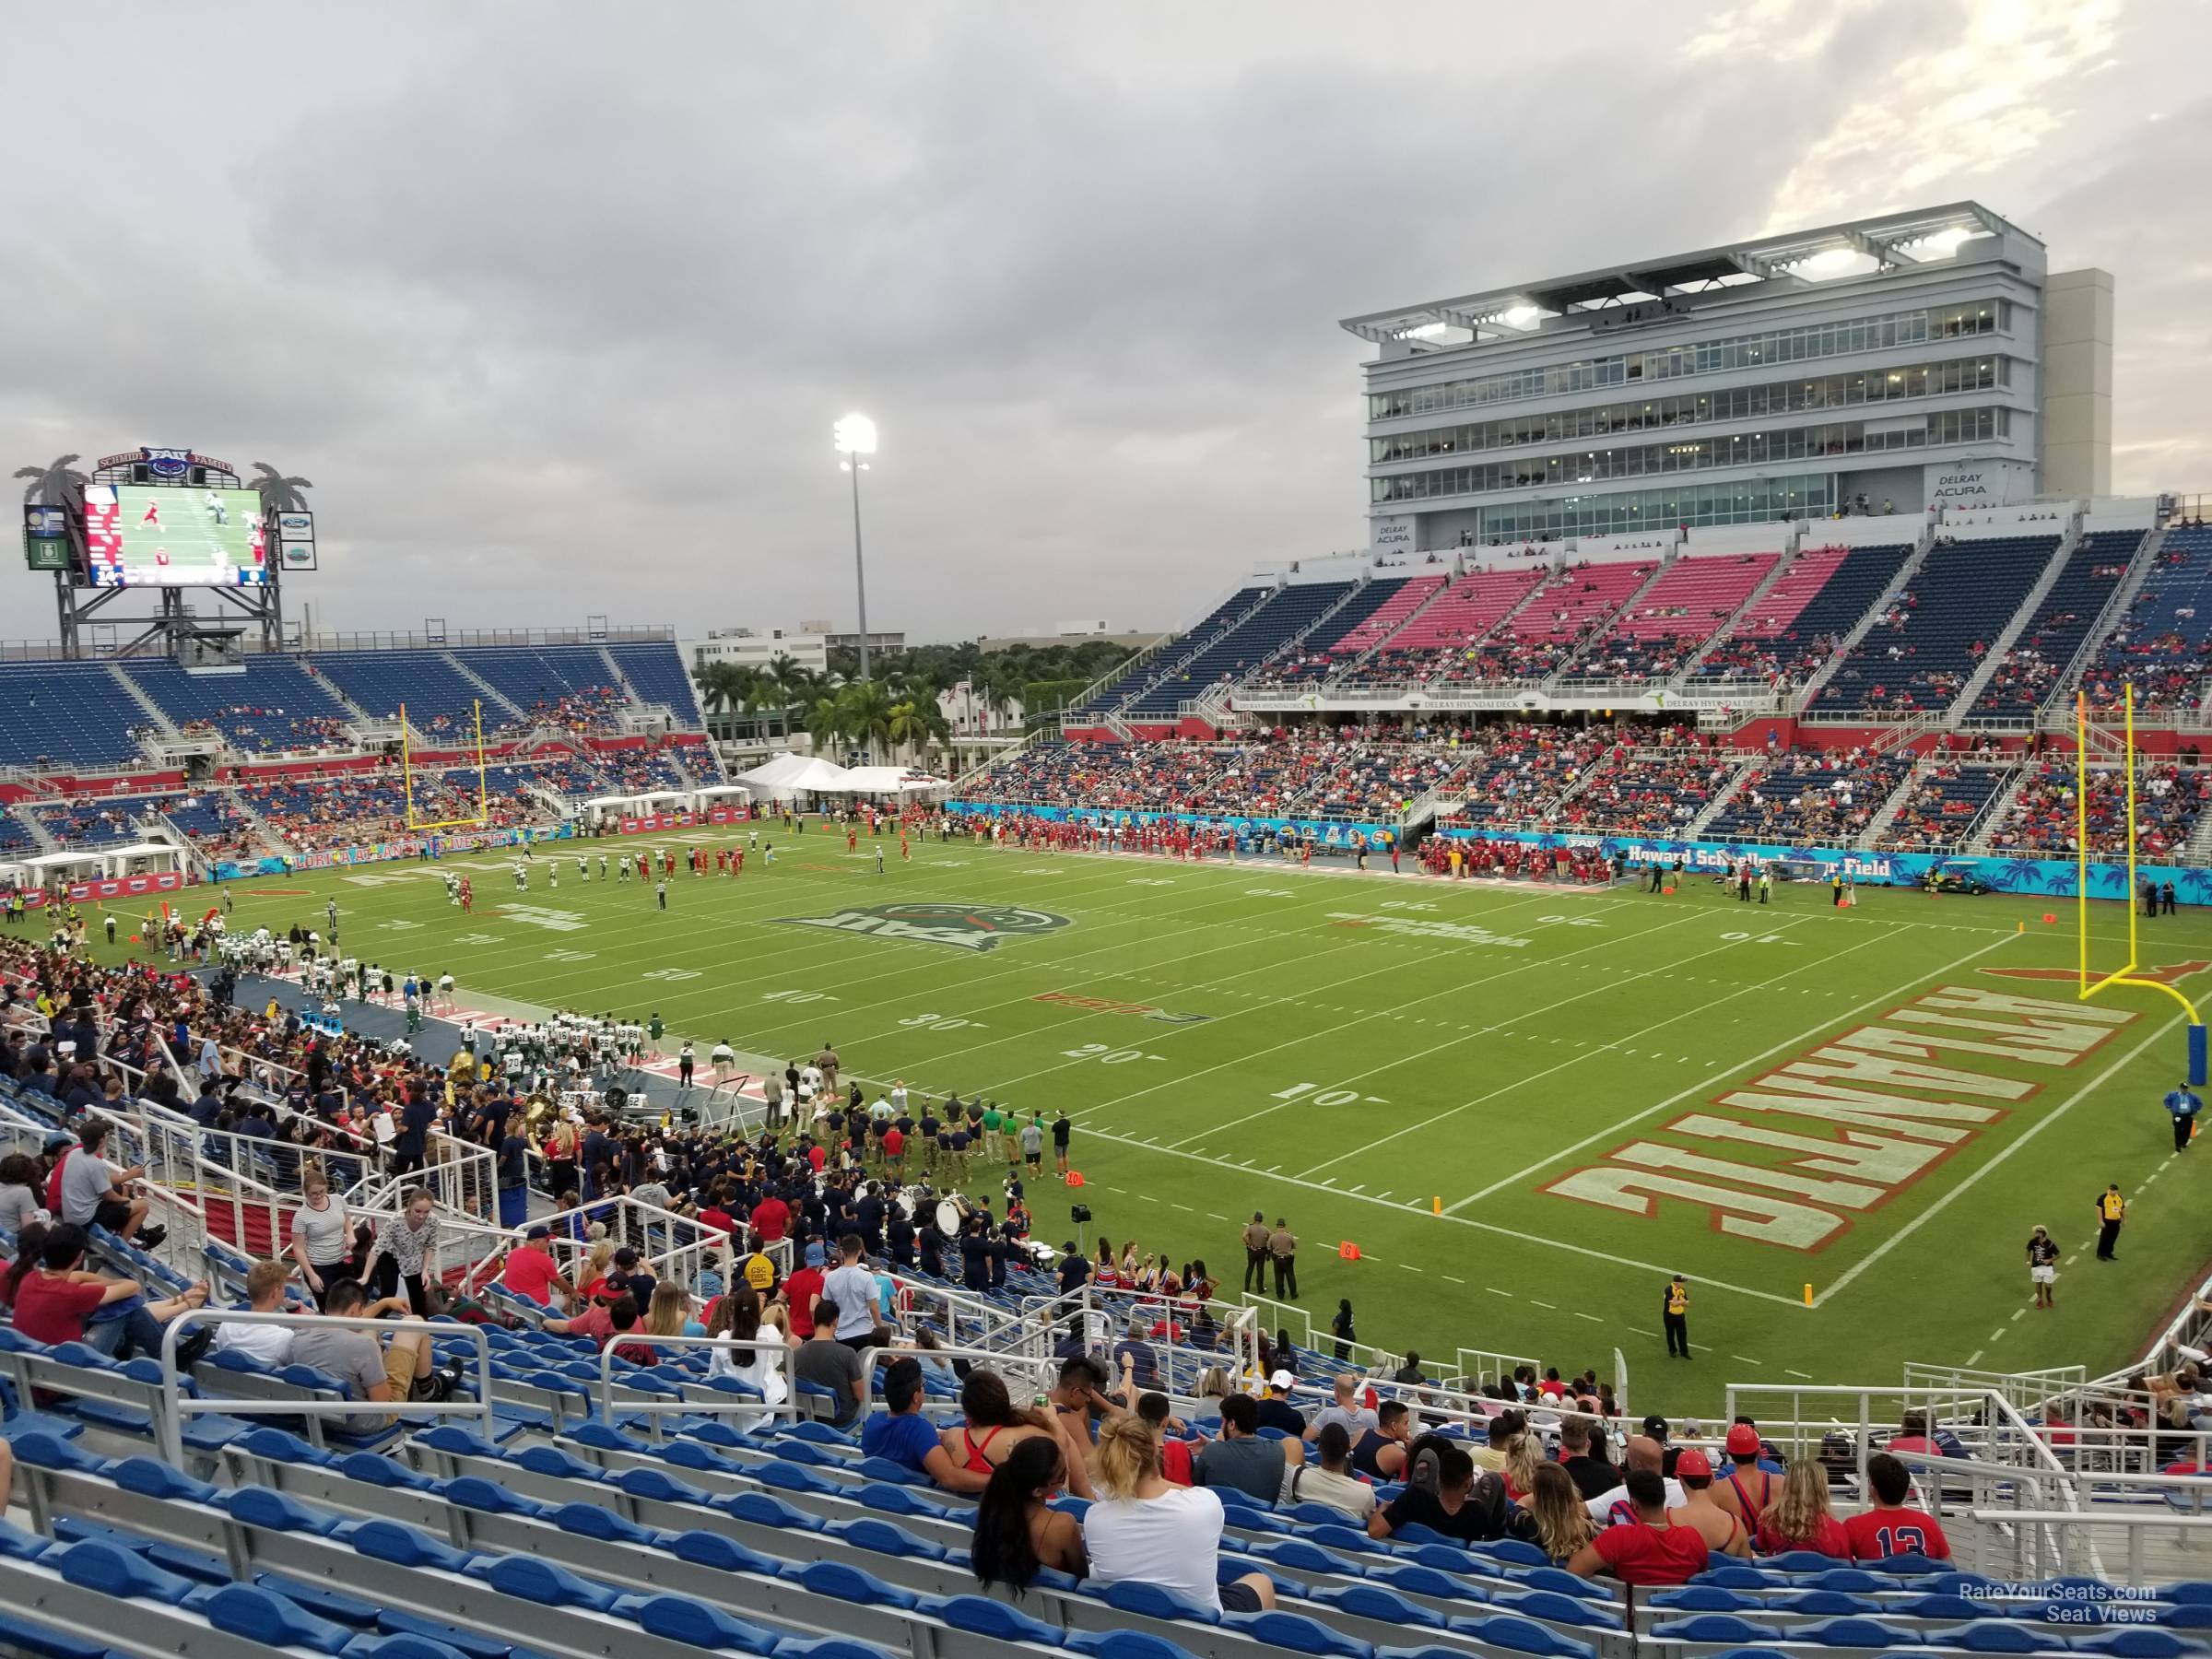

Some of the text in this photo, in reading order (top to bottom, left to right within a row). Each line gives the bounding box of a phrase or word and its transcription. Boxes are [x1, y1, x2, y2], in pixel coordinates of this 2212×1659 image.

[151, 450, 187, 461] FAU
[100, 452, 234, 473] SCHMIDT FAMILY
[1939, 474, 1983, 485] DELRAY
[1934, 486, 1986, 498] ACURA
[1380, 525, 1407, 535] DELRAY
[1377, 535, 1410, 543] ACURA
[1425, 700, 1519, 709] DELRAY HYUNDAI DECK
[574, 801, 588, 812] 32
[1569, 838, 1600, 848] FAU
[1629, 846, 1691, 865] Howard
[1844, 857, 1890, 877] Field
[1720, 932, 1785, 943] 10
[642, 968, 703, 981] 50
[762, 990, 826, 1004] 40
[898, 1013, 970, 1030] 30
[1059, 1043, 1143, 1064] 20
[508, 1058, 519, 1067] 70
[564, 1093, 575, 1103] 79
[1269, 1082, 1359, 1106] 10
[1543, 985, 2140, 1251] ATLANTIC
[1067, 1172, 1079, 1184] 10
[1345, 1244, 1352, 1255] G
[1876, 1526, 1926, 1558] 13
